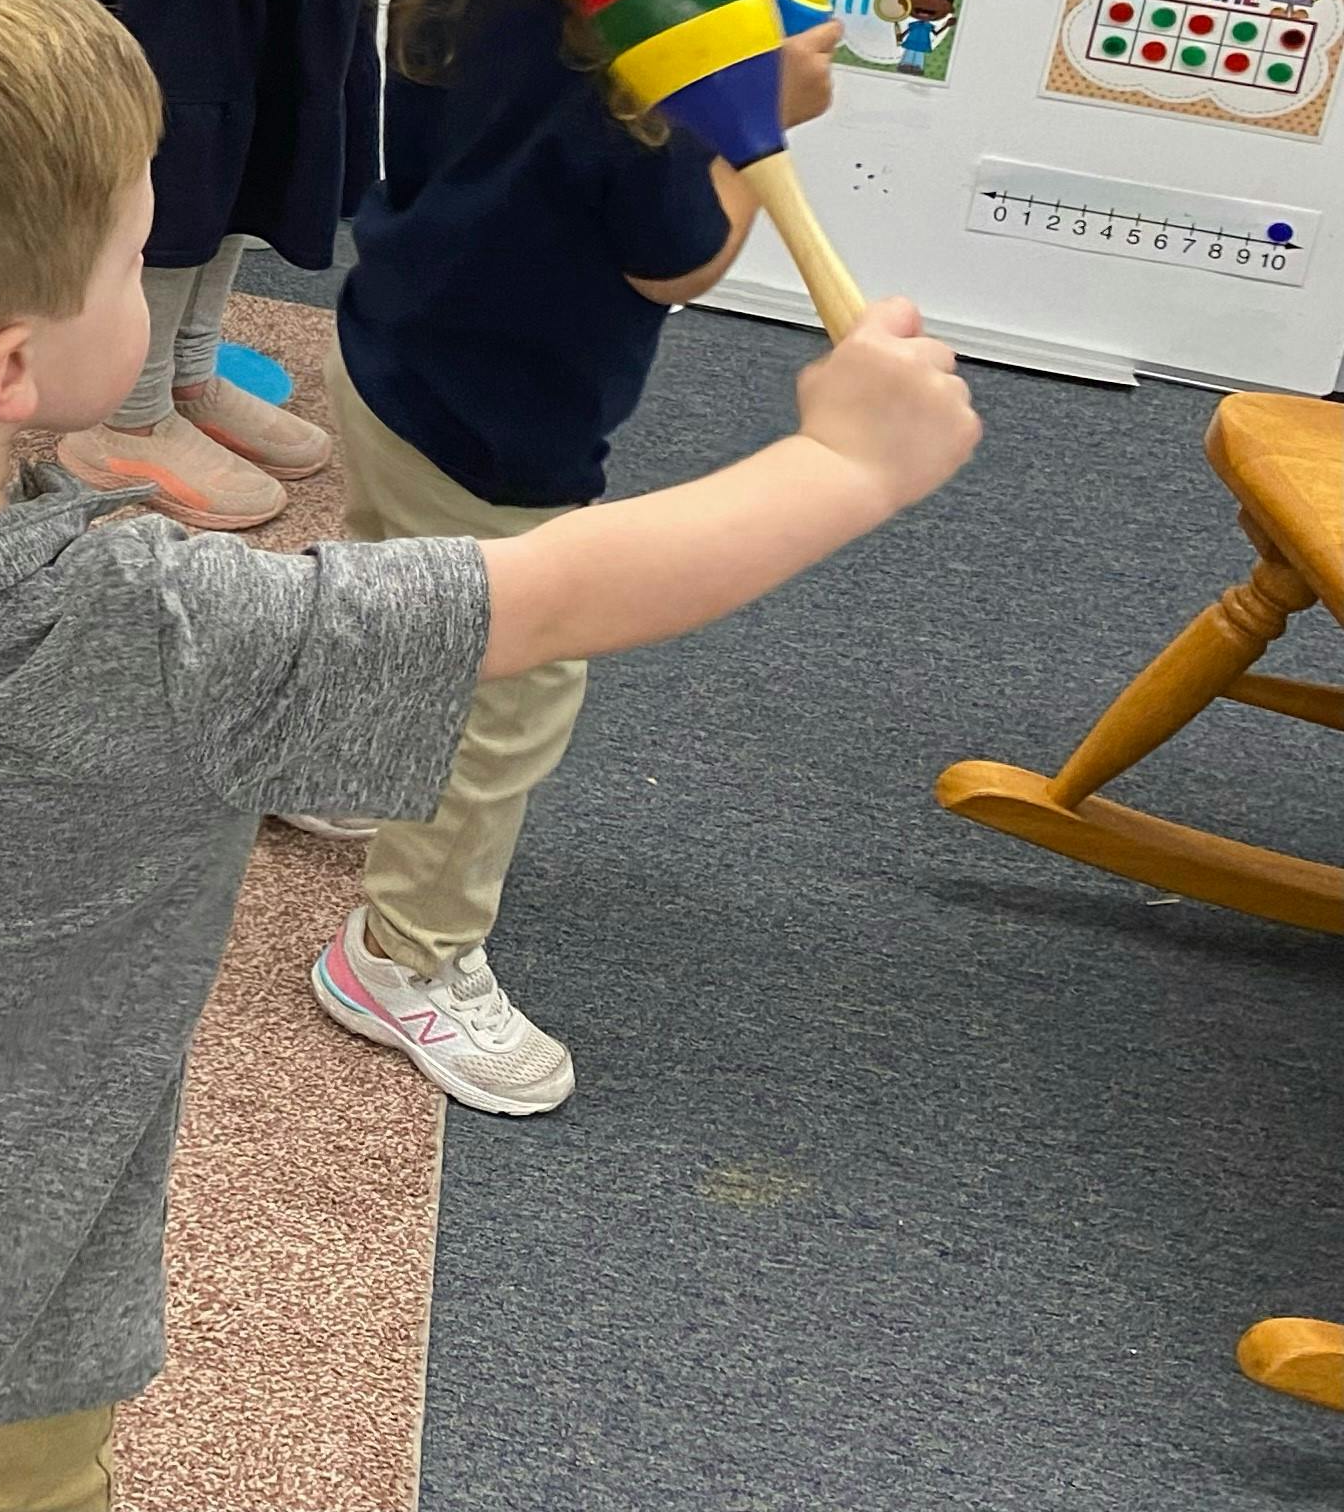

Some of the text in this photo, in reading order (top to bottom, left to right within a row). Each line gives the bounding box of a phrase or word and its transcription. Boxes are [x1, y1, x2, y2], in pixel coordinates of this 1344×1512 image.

[993, 206, 1287, 271] 0 1 2 3 4 5 6 7 8 9 10
